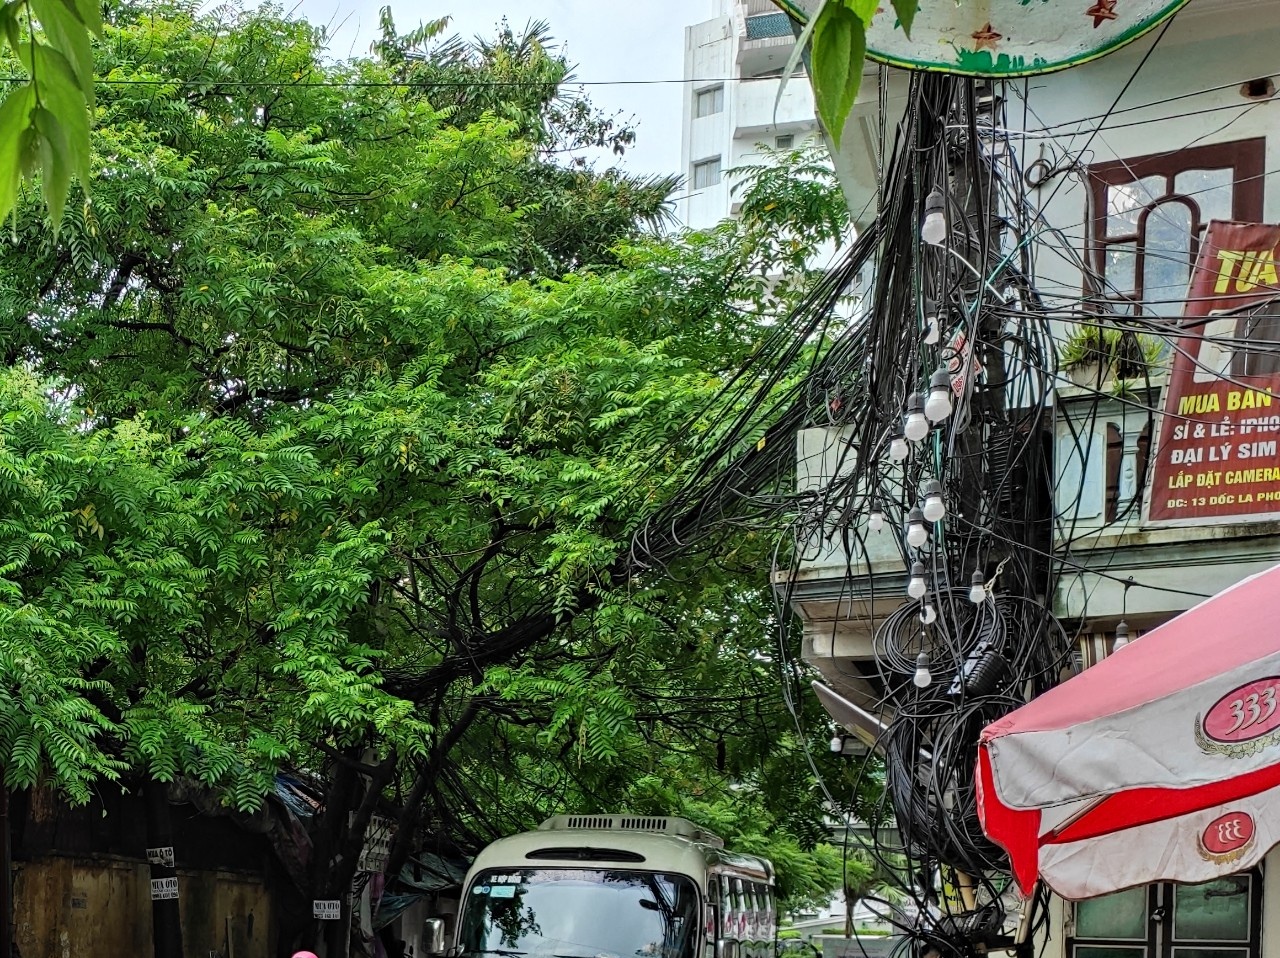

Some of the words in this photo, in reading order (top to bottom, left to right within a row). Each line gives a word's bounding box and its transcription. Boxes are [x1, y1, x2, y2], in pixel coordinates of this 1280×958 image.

[1178, 393, 1220, 416] MUA
[1193, 423, 1205, 438] &
[1171, 447, 1203, 466] ĐẠI
[1209, 442, 1232, 462] LÝ
[1238, 441, 1277, 459] SIM
[1168, 471, 1193, 489] LẮP
[1225, 467, 1280, 484] CAMERA
[1192, 498, 1206, 506] 13
[1238, 494, 1253, 503] LA
[1225, 686, 1277, 735] 333
